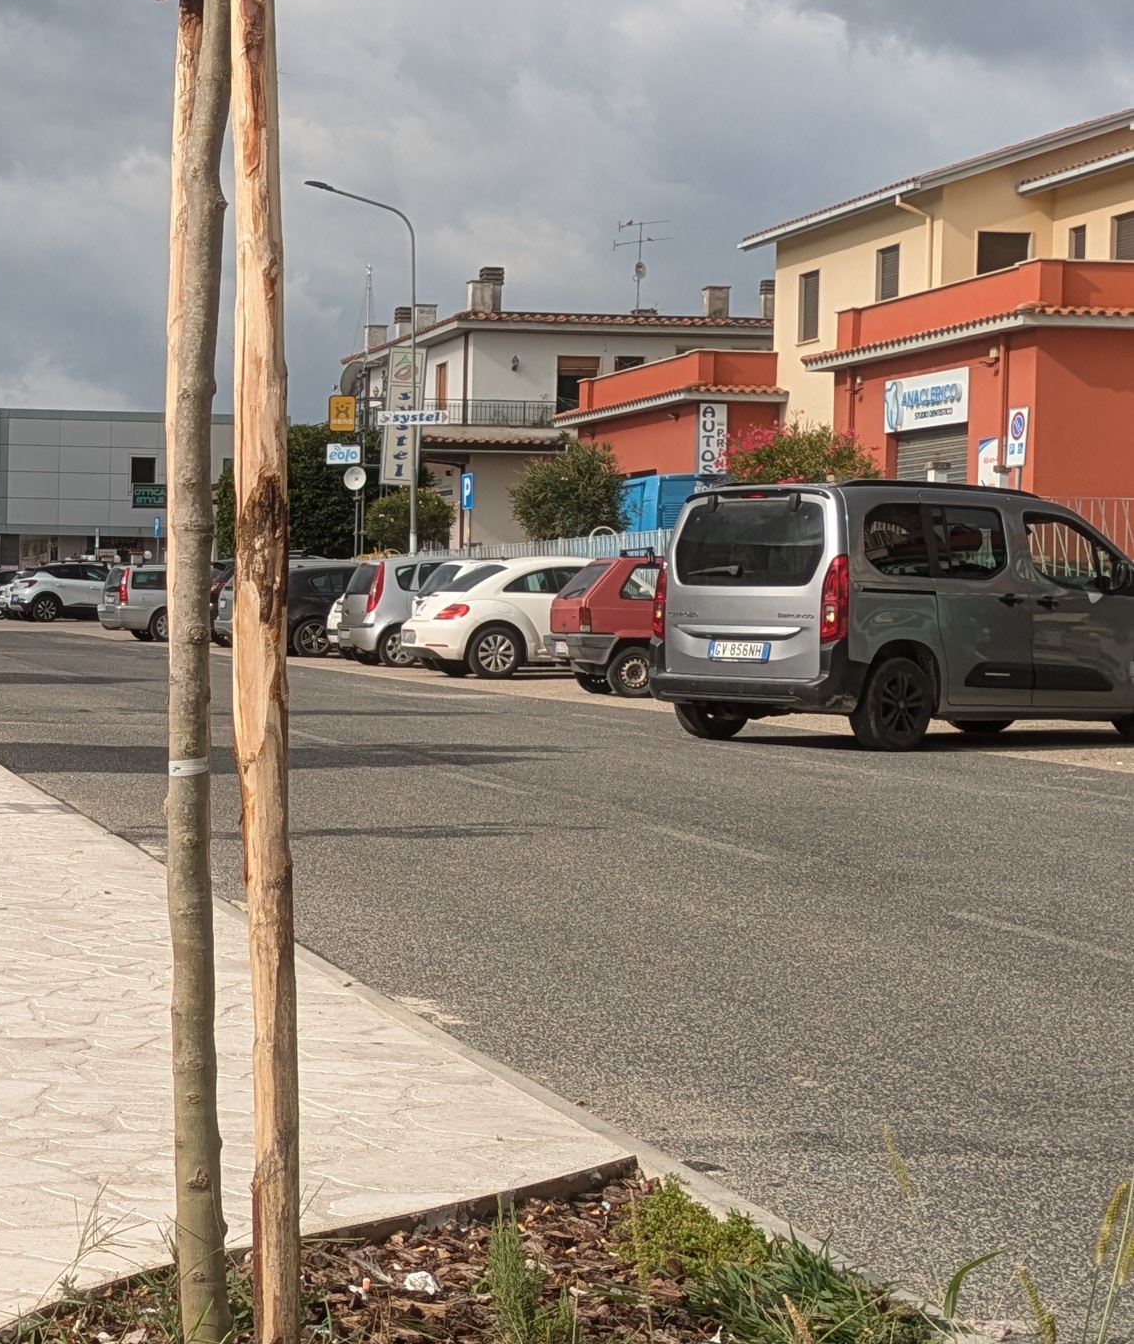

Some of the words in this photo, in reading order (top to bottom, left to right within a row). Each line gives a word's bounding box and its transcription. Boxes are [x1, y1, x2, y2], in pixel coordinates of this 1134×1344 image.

[901, 383, 957, 406] ANACLERICO
[392, 412, 440, 424] systel
[329, 449, 358, 461] eolo
[463, 477, 471, 506] P
